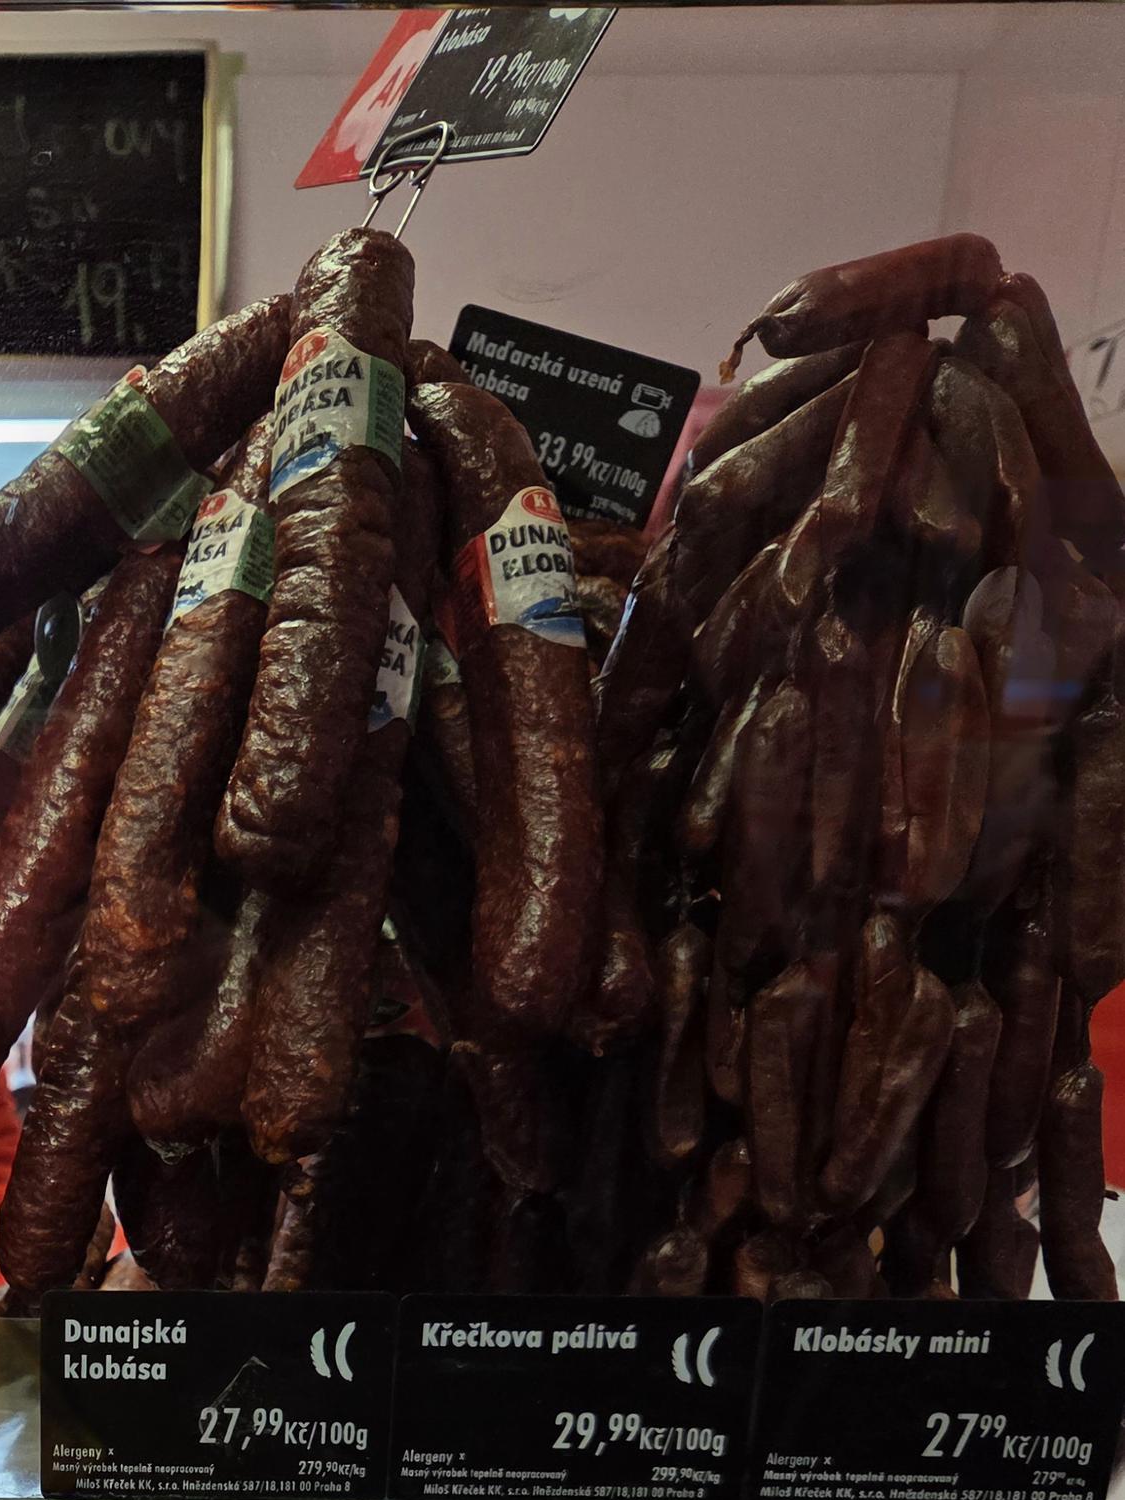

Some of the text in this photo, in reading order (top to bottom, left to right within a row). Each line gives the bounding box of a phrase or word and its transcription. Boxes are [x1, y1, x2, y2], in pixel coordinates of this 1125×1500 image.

[466, 331, 625, 396] Maďarská uzená
[64, 1318, 187, 1349] Dunajská
[422, 1322, 638, 1354] Křečkova pálivá
[793, 1326, 991, 1359] Klobásky mini
[64, 1354, 167, 1380] klobása
[53, 1444, 102, 1460] Alergeny
[402, 1450, 453, 1466] Alergeny
[52, 1461, 215, 1476] Masný výrobek tepelně neopracovaný
[766, 1453, 818, 1468] Alergeny
[400, 1467, 567, 1482] Masný výrobek tepelně neopracovaný
[763, 1470, 959, 1486] Masný výrobek tepelně neopracovaný
[76, 1478, 101, 1489] Miloš
[103, 1478, 136, 1490] Křeček
[138, 1480, 155, 1492] KK,
[158, 1481, 181, 1491] s.r.o.
[182, 1480, 240, 1492] Hnězdenská
[299, 1481, 312, 1492] 00
[314, 1481, 342, 1492] Praha
[344, 1481, 351, 1492] 8
[424, 1484, 449, 1495] Miloš
[651, 1487, 664, 1498] 00
[666, 1487, 695, 1498] Praha
[697, 1487, 704, 1498] 8
[760, 1486, 792, 1498] Miloš
[794, 1487, 832, 1499] Křeček
[835, 1488, 856, 1500] KK,
[858, 1489, 885, 1500] s.r.o.
[889, 1488, 958, 1500] Hnězdenská
